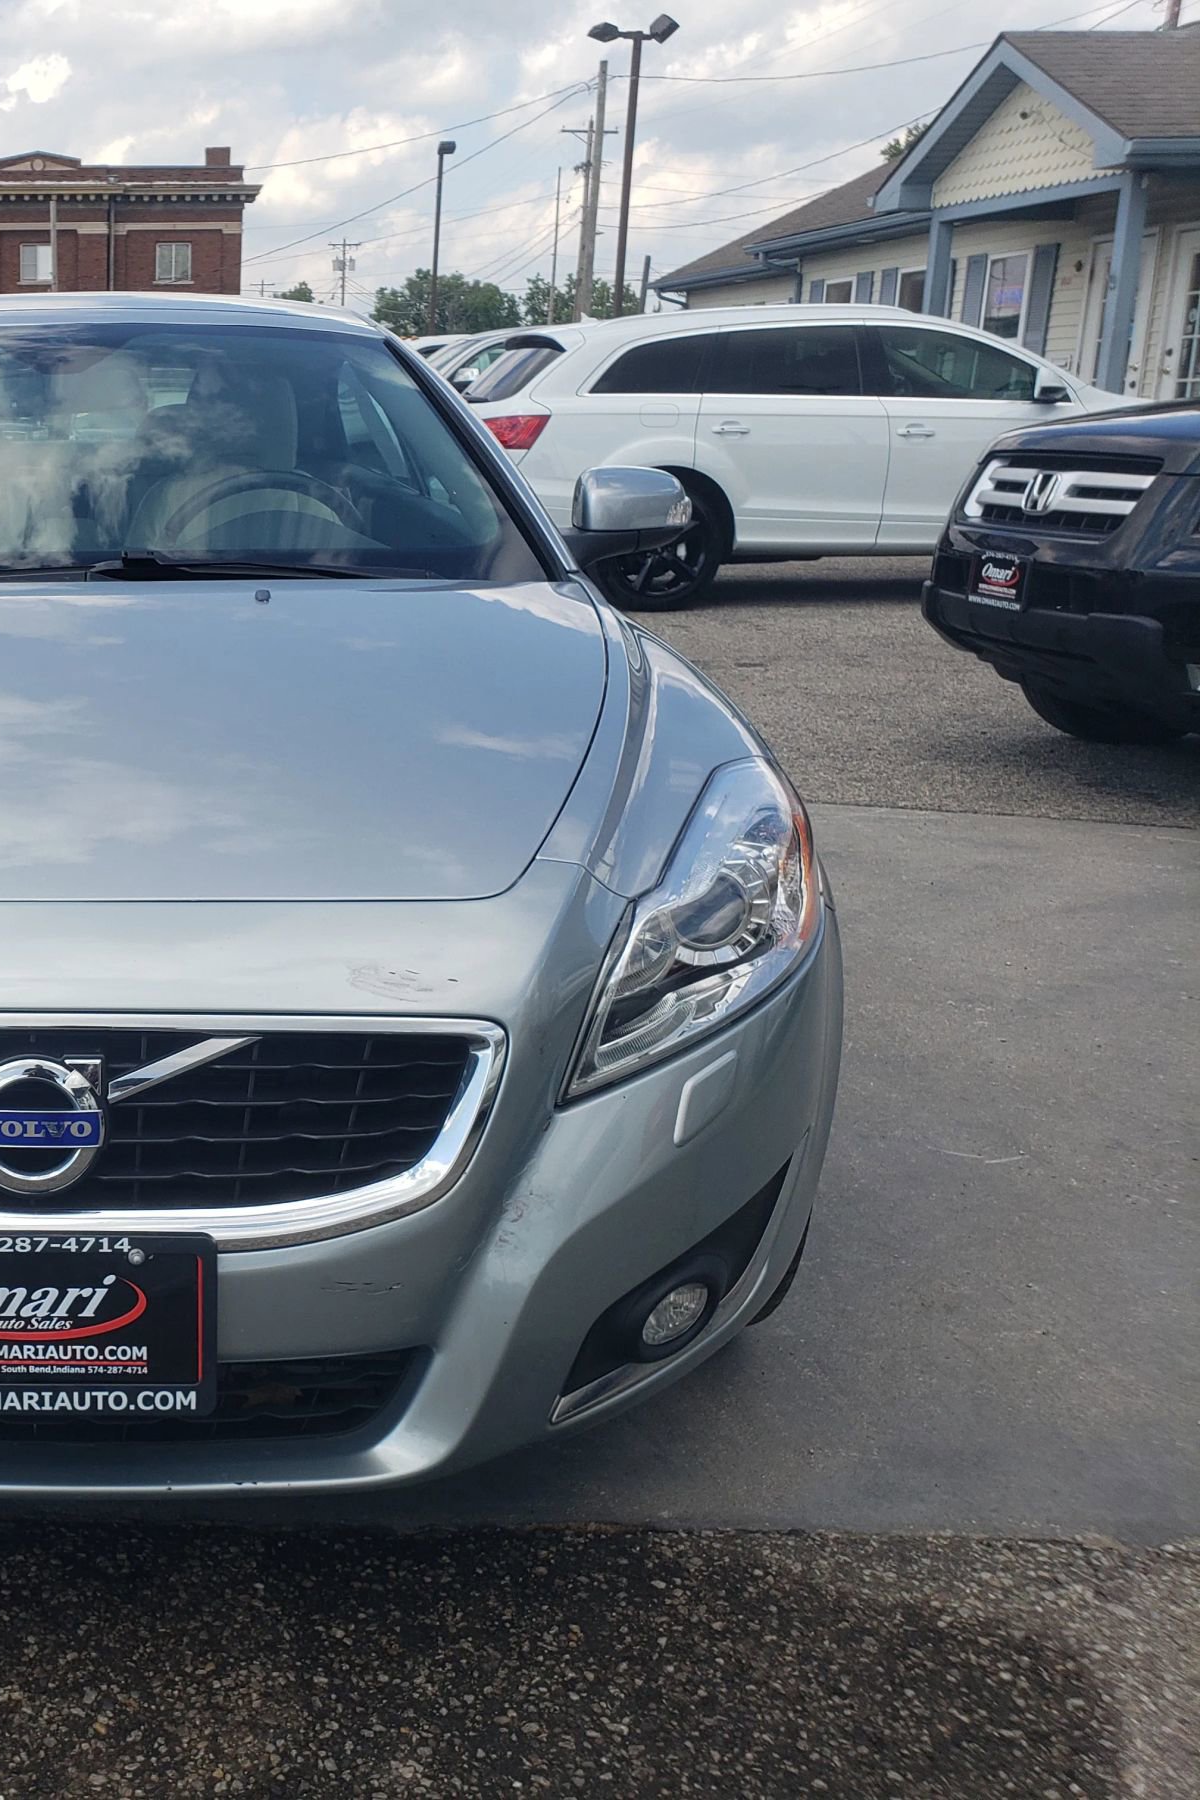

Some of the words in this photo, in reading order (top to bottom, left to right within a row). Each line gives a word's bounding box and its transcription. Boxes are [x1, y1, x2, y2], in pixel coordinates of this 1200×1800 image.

[27, 1317, 74, 1330] Sales
[1, 1365, 27, 1373] South
[87, 1365, 148, 1374] 574-287-4714
